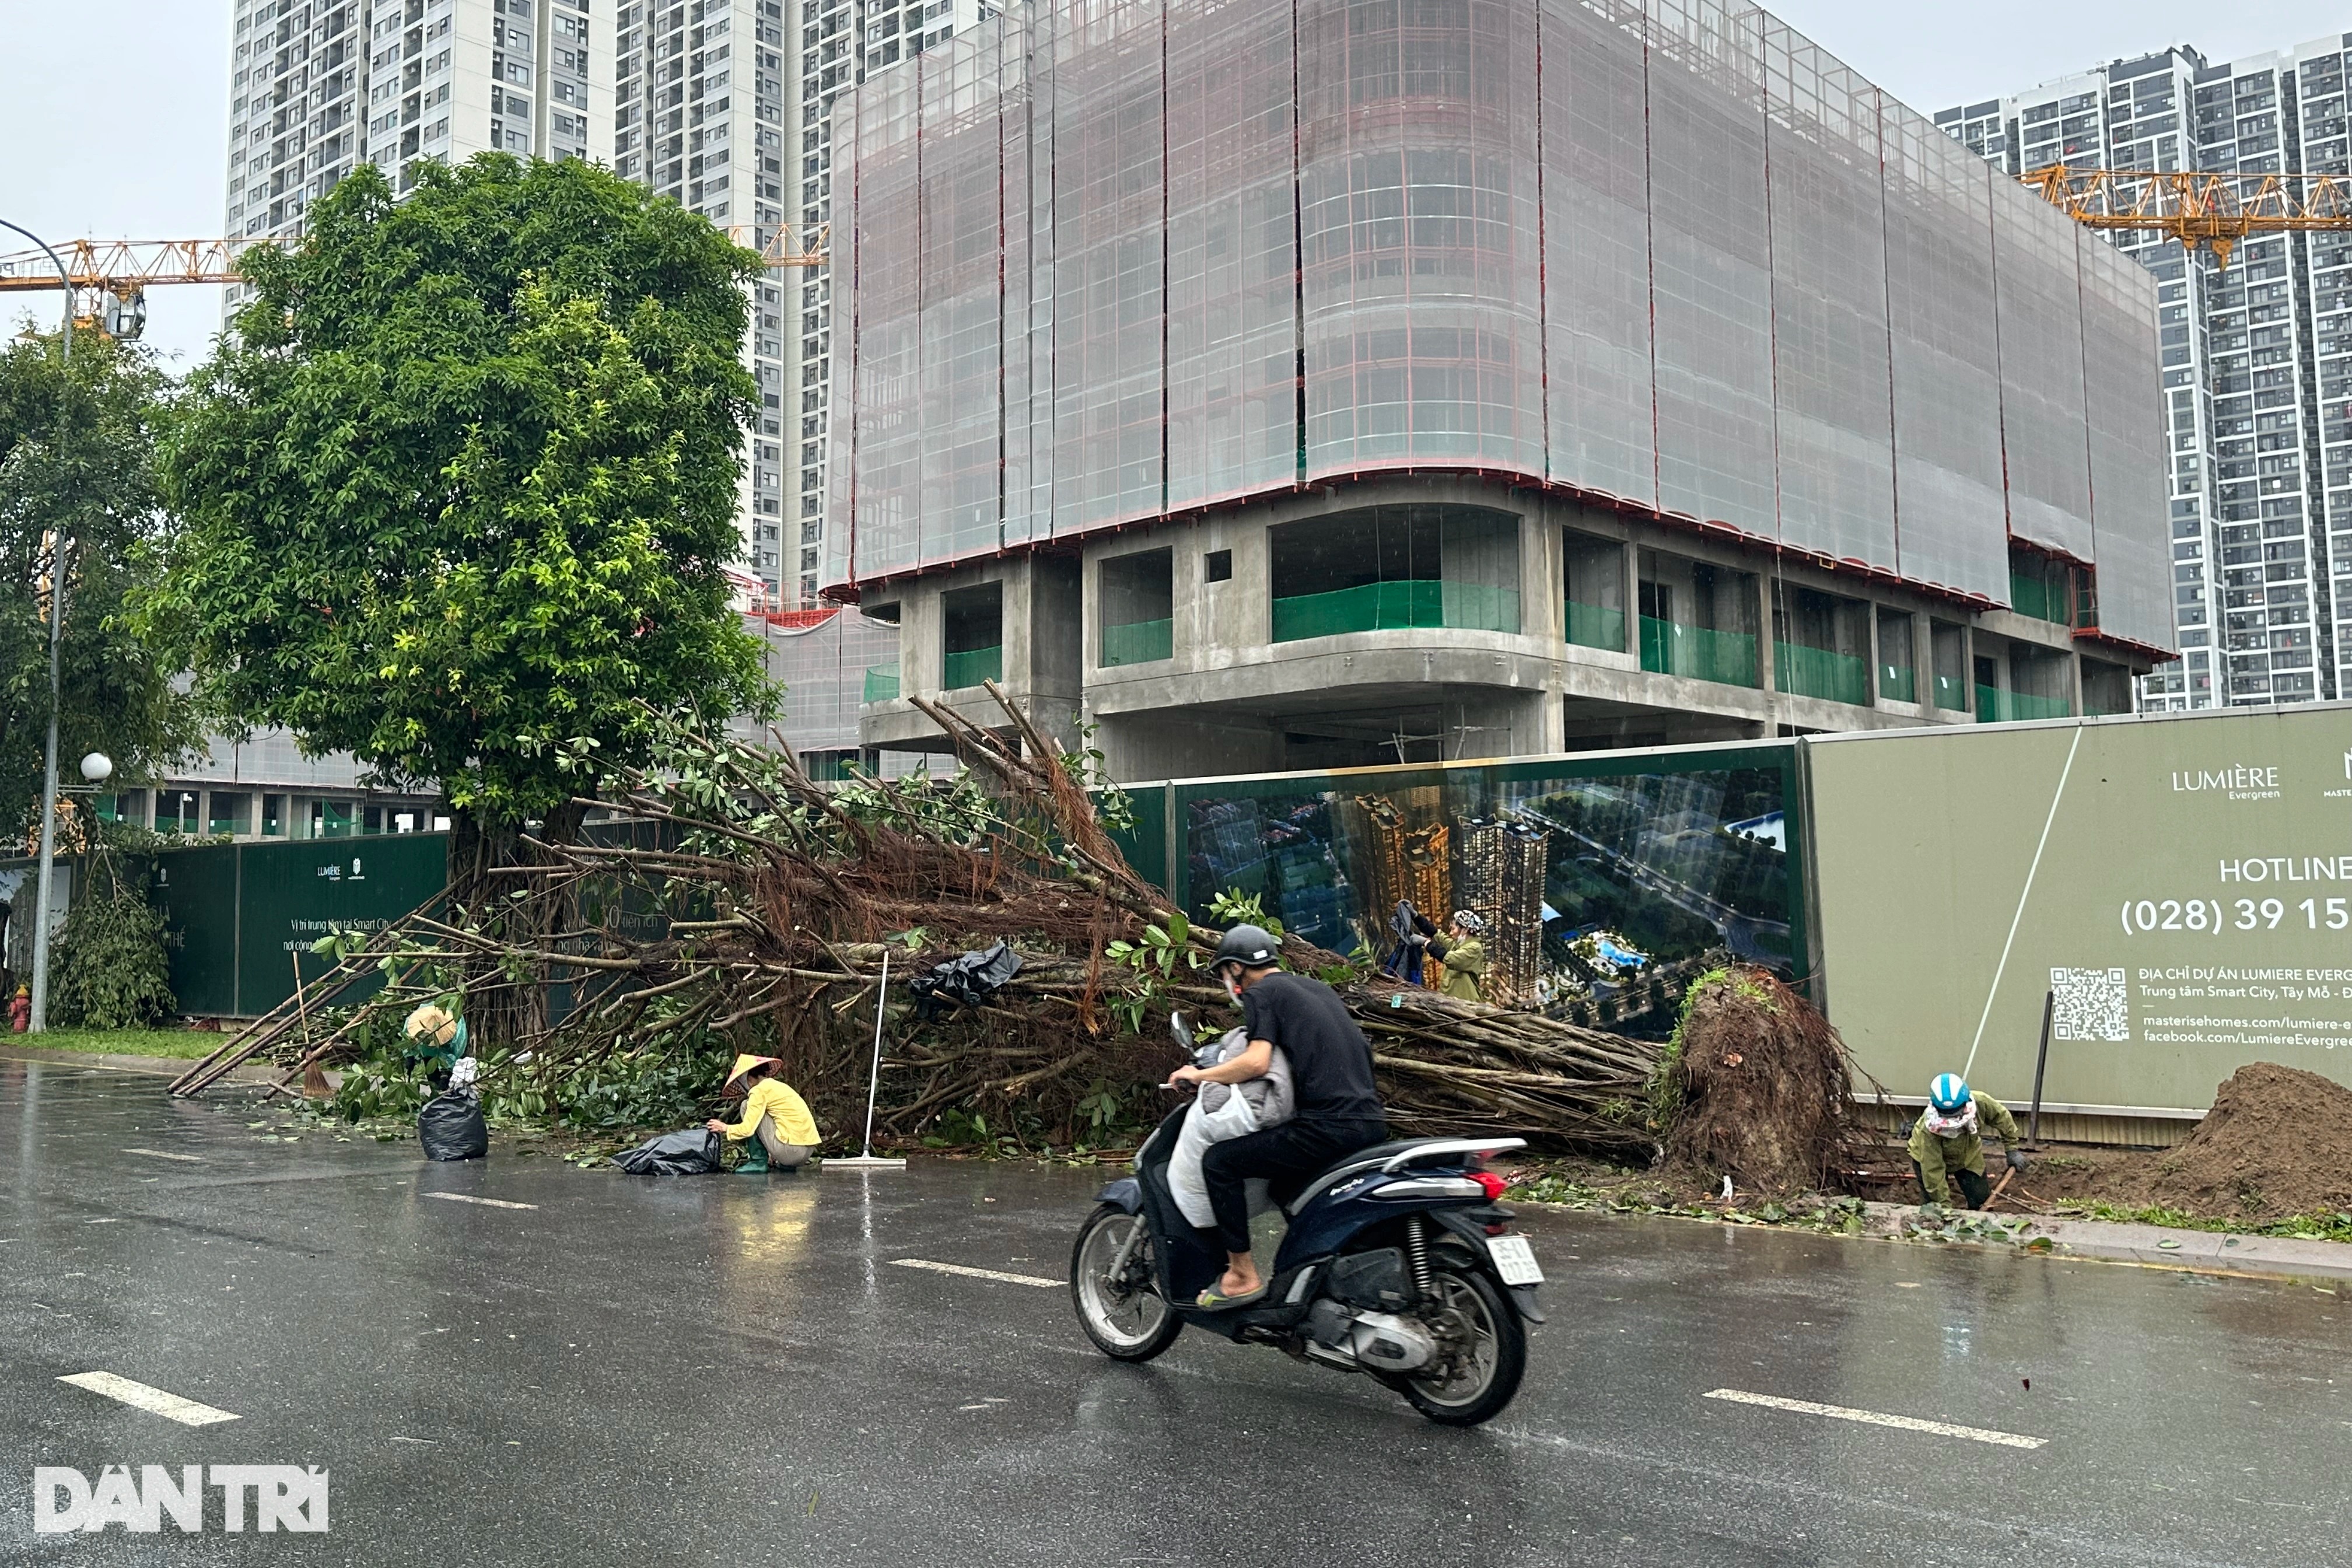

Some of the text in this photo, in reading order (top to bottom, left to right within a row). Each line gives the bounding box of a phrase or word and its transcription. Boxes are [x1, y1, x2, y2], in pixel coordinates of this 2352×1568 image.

[2172, 763, 2279, 791] LUMIÈRE
[2229, 790, 2280, 800] Evergreen
[2220, 856, 2352, 882] HOTLINE
[2122, 898, 2348, 935] (028) 39 15
[308, 919, 326, 932] trung
[354, 918, 376, 930] Smart
[2139, 965, 2352, 982] ĐỊA CHỈ DỰ ÁN LUMIERE EVERG
[2140, 985, 2176, 999] Trung
[2179, 986, 2204, 996] tâm
[2207, 986, 2246, 998] Smart
[2249, 986, 2278, 1000] City,
[2280, 986, 2304, 1000] Tây
[2308, 985, 2330, 999] Mỗ
[2143, 1015, 2352, 1030] masterisehomes.com/lumiere-e
